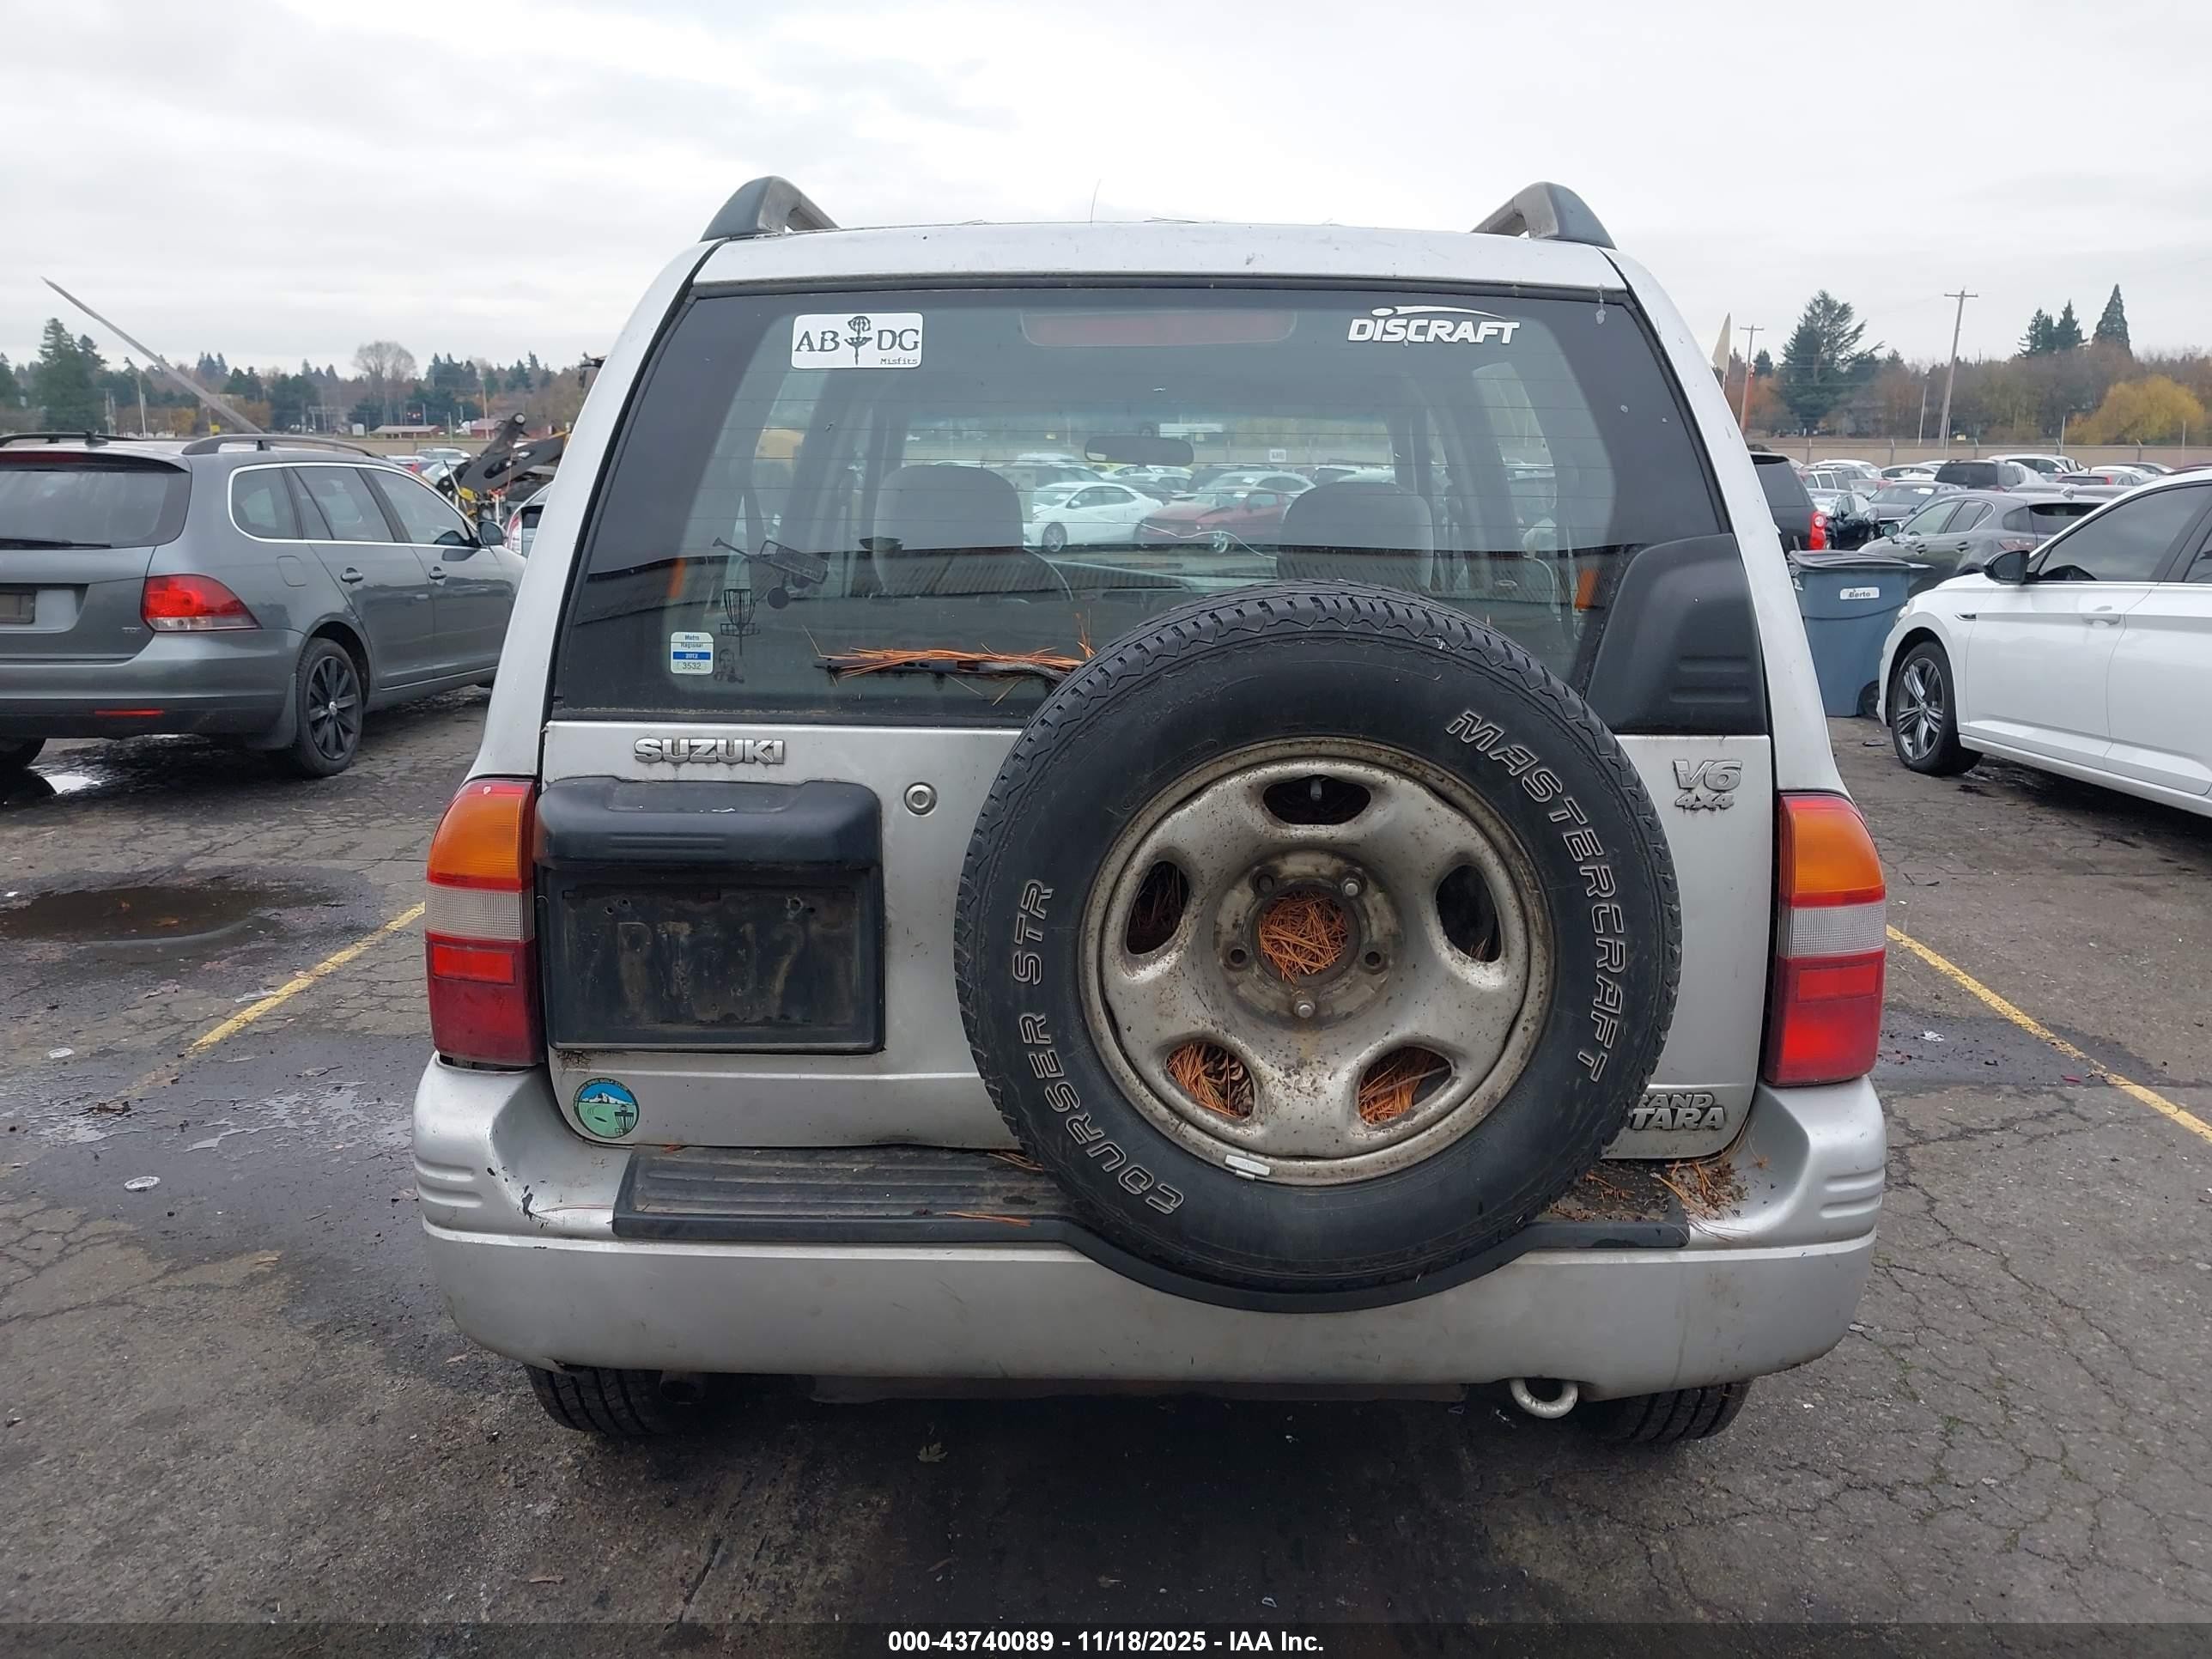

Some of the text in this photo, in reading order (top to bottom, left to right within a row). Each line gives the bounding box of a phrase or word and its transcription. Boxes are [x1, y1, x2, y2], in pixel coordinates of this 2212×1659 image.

[794, 329, 920, 352] AB DG
[1347, 316, 1520, 344] DISCRAFT
[635, 738, 785, 764] SUZUKI
[1673, 759, 1742, 792] V6
[1444, 709, 1626, 1082] MASTERCRAFT
[1012, 878, 1184, 1214] COURSER STR
[1638, 1093, 1714, 1109] RAND
[1632, 1107, 1726, 1130] TARA
